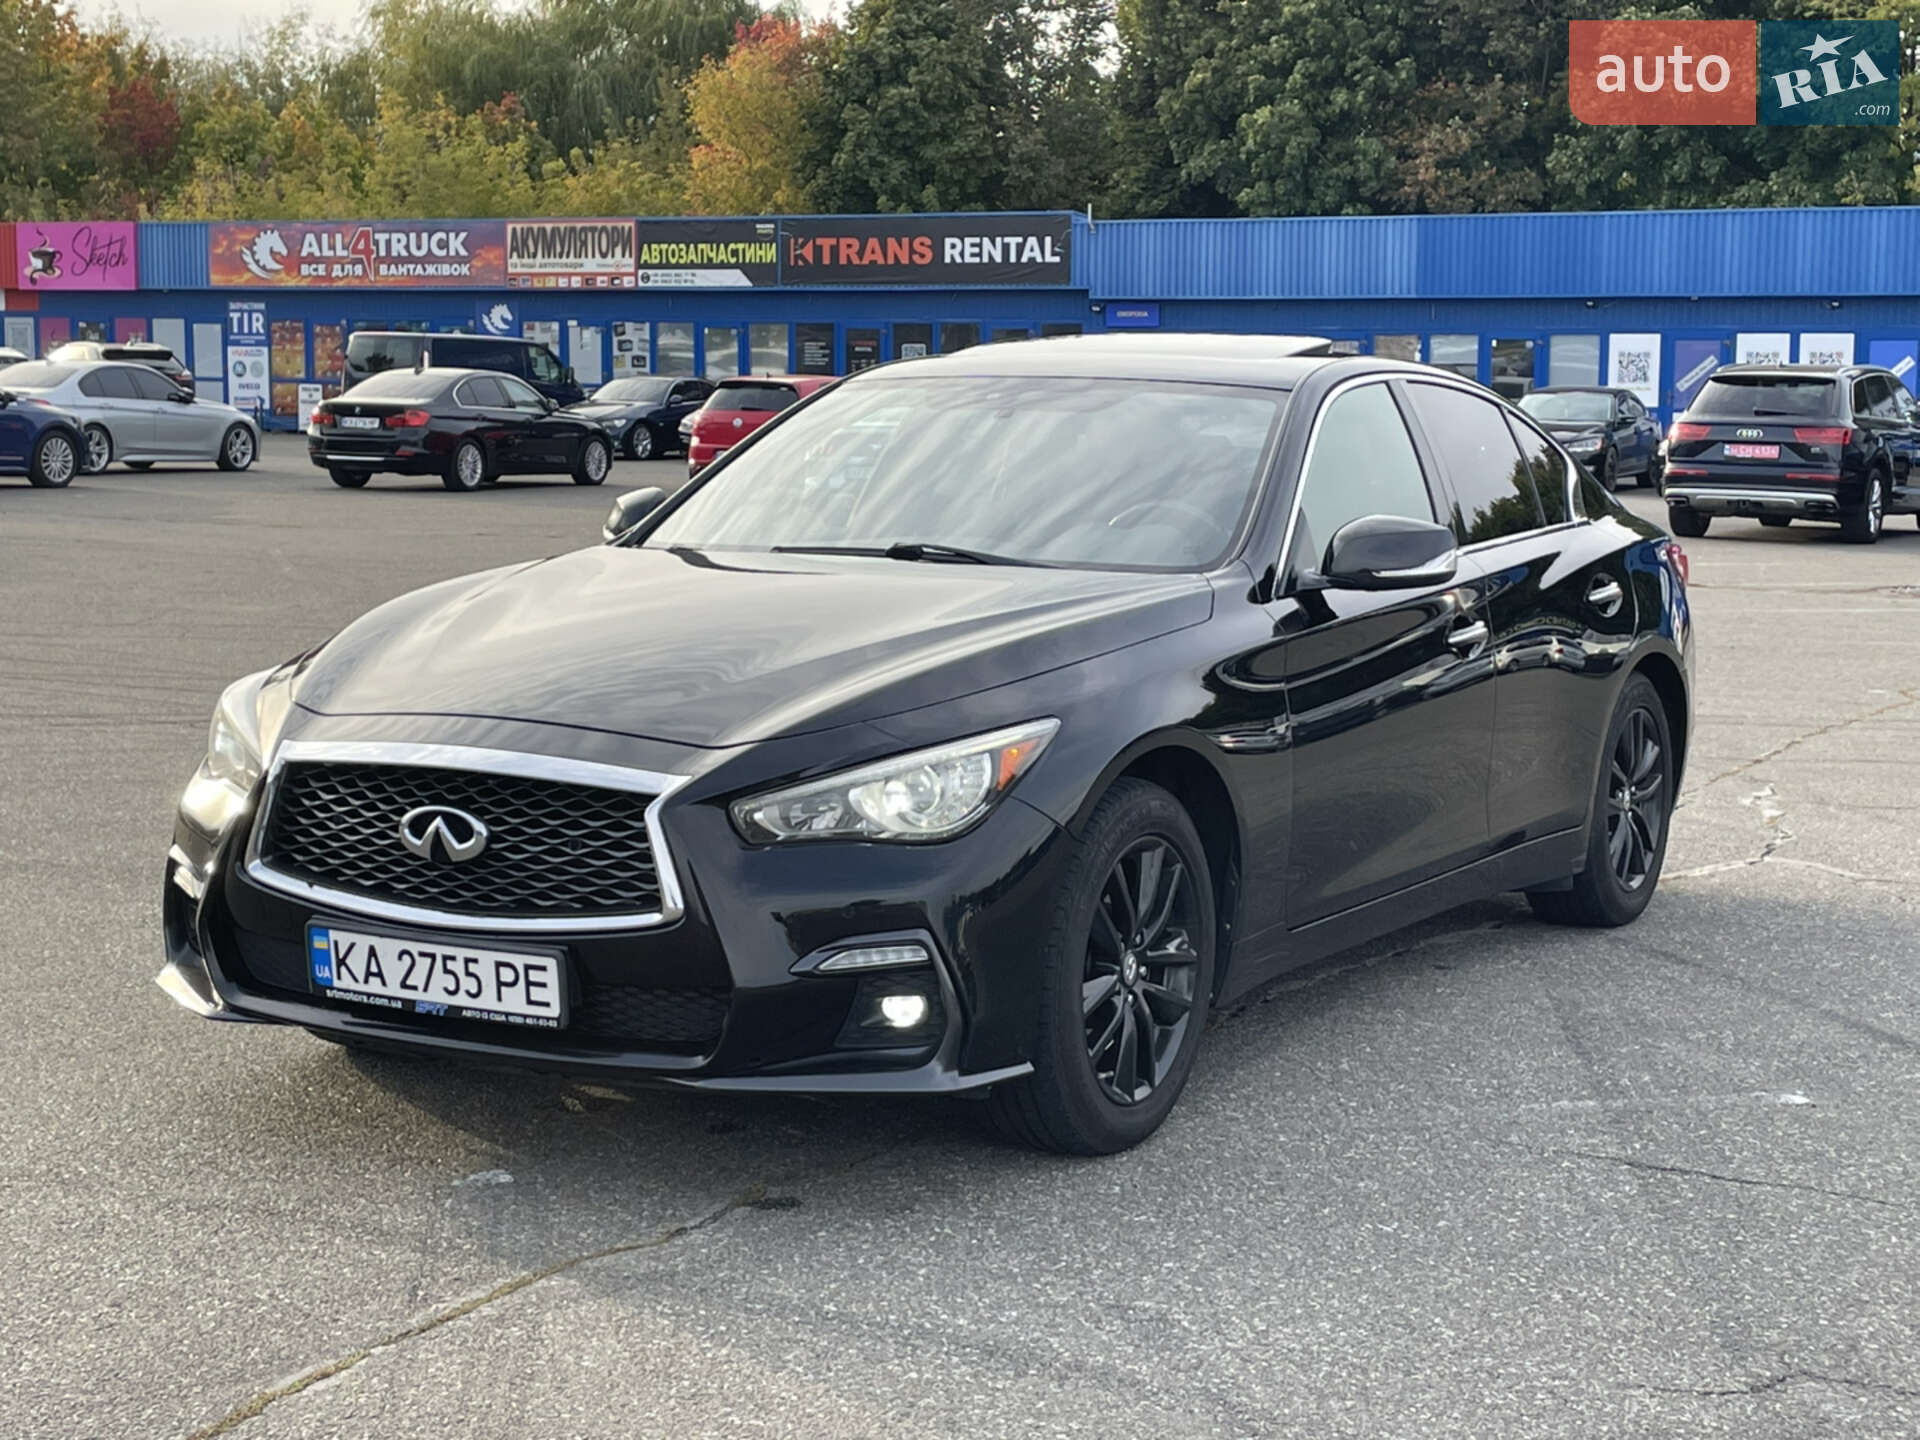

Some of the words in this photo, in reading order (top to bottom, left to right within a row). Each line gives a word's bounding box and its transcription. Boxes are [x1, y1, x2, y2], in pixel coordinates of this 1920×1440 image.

[71, 225, 129, 283] Sketch
[508, 225, 633, 260] АКУМУЛЯТОРИ
[640, 242, 777, 265] АВТОЗАПЧАСТИНИ
[943, 236, 1062, 264] RENTAL
[300, 264, 326, 276] ВСЕ
[331, 263, 363, 277] ДЛЯ
[379, 263, 470, 276] ВАНТАЖІВОК
[229, 312, 264, 334] TIR
[316, 964, 331, 981] UA
[333, 939, 387, 988] KA
[397, 949, 483, 999] 2755
[495, 960, 552, 1008] PE
